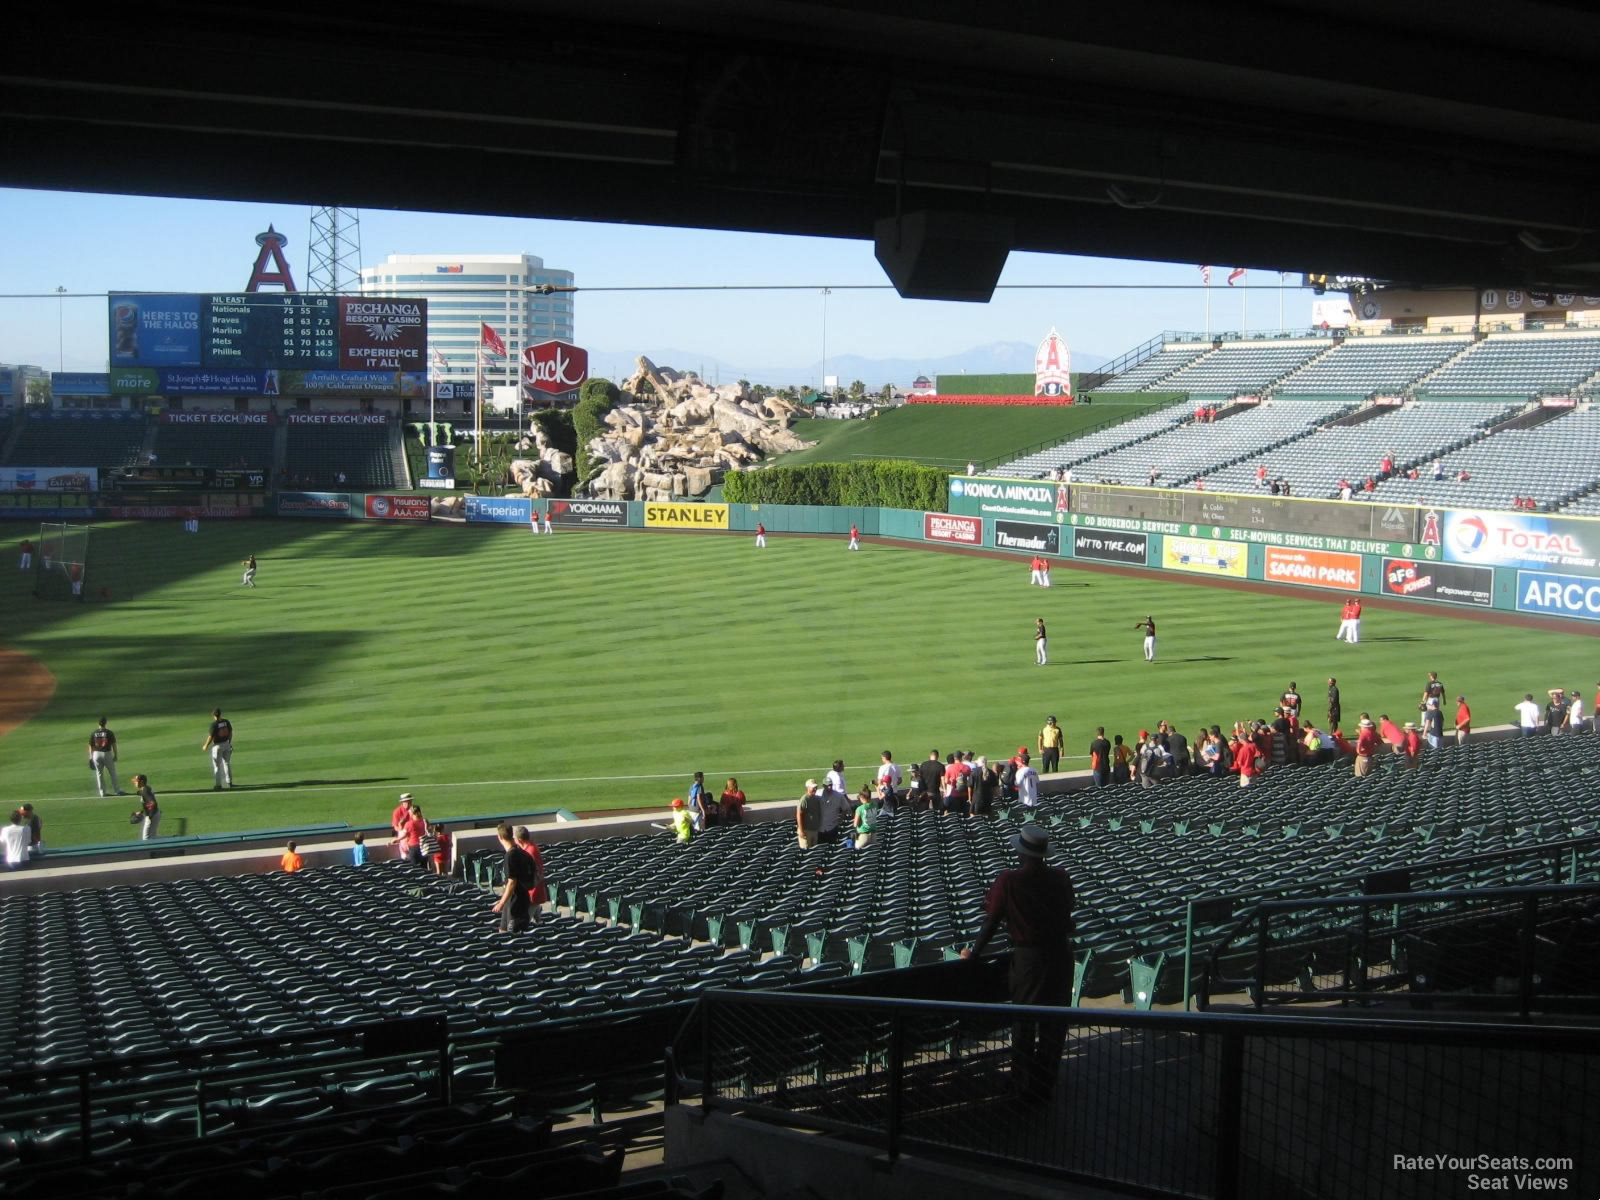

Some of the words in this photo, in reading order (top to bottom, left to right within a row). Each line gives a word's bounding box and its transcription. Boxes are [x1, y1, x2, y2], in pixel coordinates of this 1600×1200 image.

[1486, 292, 1494, 303] 11
[346, 303, 420, 315] PECHANGA
[143, 311, 181, 321] HERE'S
[184, 312, 199, 321] TO
[212, 316, 240, 324] Braves
[346, 315, 380, 323] RESORT
[388, 316, 421, 324] CASINO
[143, 320, 163, 329] THE
[164, 321, 199, 329] HALOS
[348, 348, 419, 358] EXPERIENCE
[366, 358, 377, 367] IT
[379, 358, 401, 367] ALL
[526, 347, 585, 385] Jack
[116, 377, 151, 388] more
[210, 374, 231, 385] Hoag
[231, 374, 257, 383] Health
[312, 374, 339, 383] Artfully
[341, 374, 368, 382] Crafted
[369, 374, 387, 382] With
[327, 382, 363, 390] California
[364, 383, 394, 391] Oranges
[168, 414, 208, 423] TICKET
[290, 414, 328, 423] TICKET
[964, 482, 1003, 498] KONICA
[1005, 486, 1053, 502] MINOLTA
[480, 503, 525, 517] Experian
[569, 503, 622, 515] YOKOHAMA
[647, 507, 726, 523] STANLEY
[930, 517, 976, 532] PECHANGA
[1085, 516, 1096, 526] OD
[1097, 518, 1141, 530] HOUSEHOLD
[997, 532, 1047, 550] Thermador
[1230, 529, 1282, 545] SELF-MOVING
[1285, 536, 1325, 548] SERVICES
[1326, 538, 1348, 550] THAT
[1497, 527, 1582, 553] TOTAL
[1076, 535, 1102, 550] NITTO
[1104, 539, 1145, 556] TIRE.COM
[1269, 561, 1316, 578] SAFARI
[1318, 565, 1357, 584] PARK
